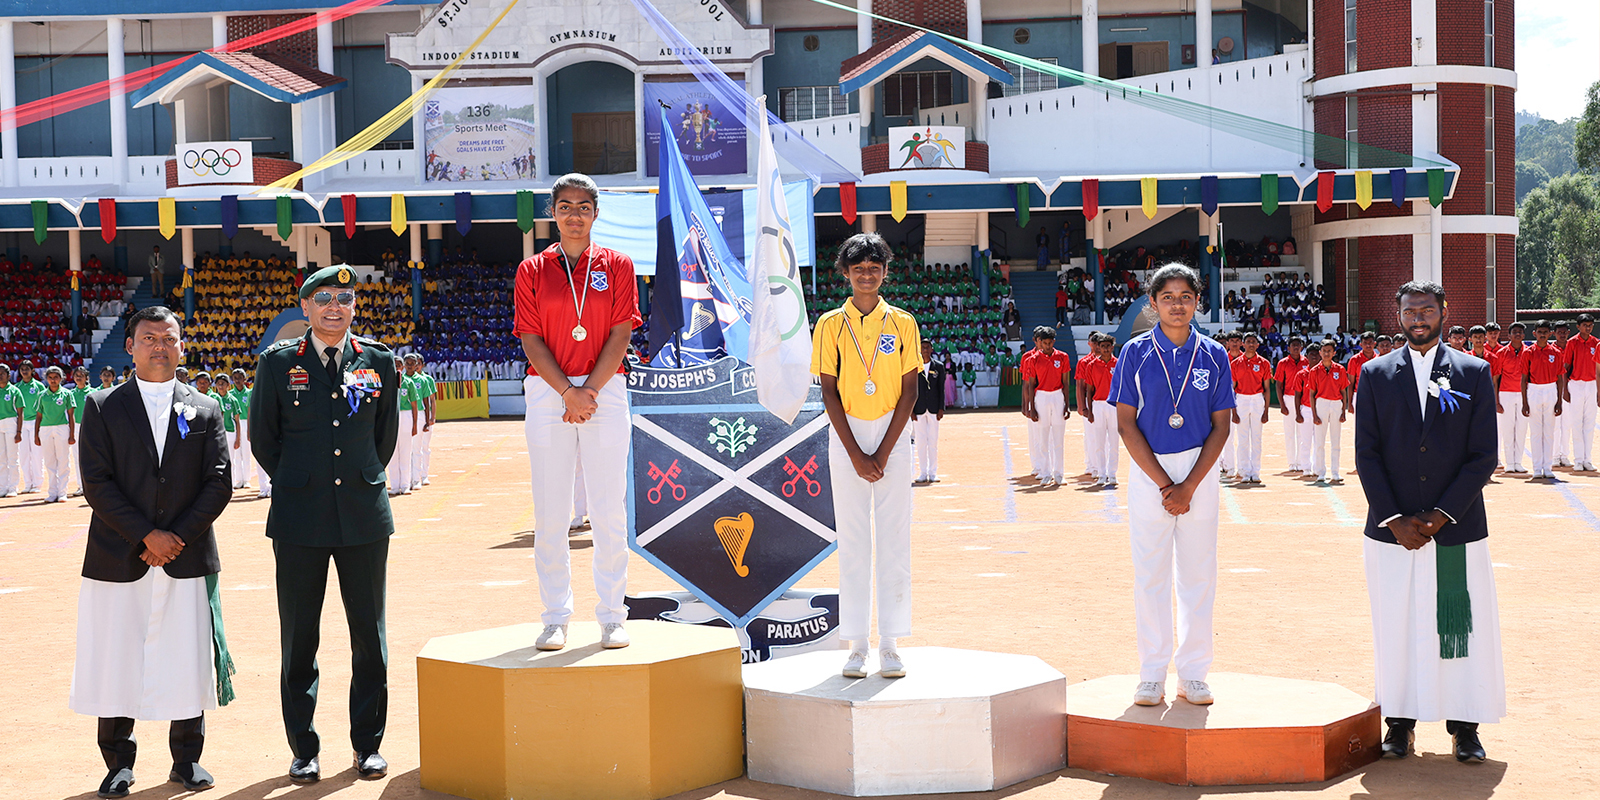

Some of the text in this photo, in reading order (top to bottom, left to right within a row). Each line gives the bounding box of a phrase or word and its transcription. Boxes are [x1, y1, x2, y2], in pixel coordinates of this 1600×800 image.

[549, 29, 617, 44] GYMNASIUM
[470, 50, 520, 60] STADIUM
[467, 105, 490, 117] 136
[455, 123, 507, 134] Sports Meet
[691, 154, 701, 162] TO
[701, 149, 723, 162] SPORT
[628, 371, 647, 387] ST
[650, 367, 717, 389] JOSEPH'S
[767, 616, 829, 639] PARATUS
